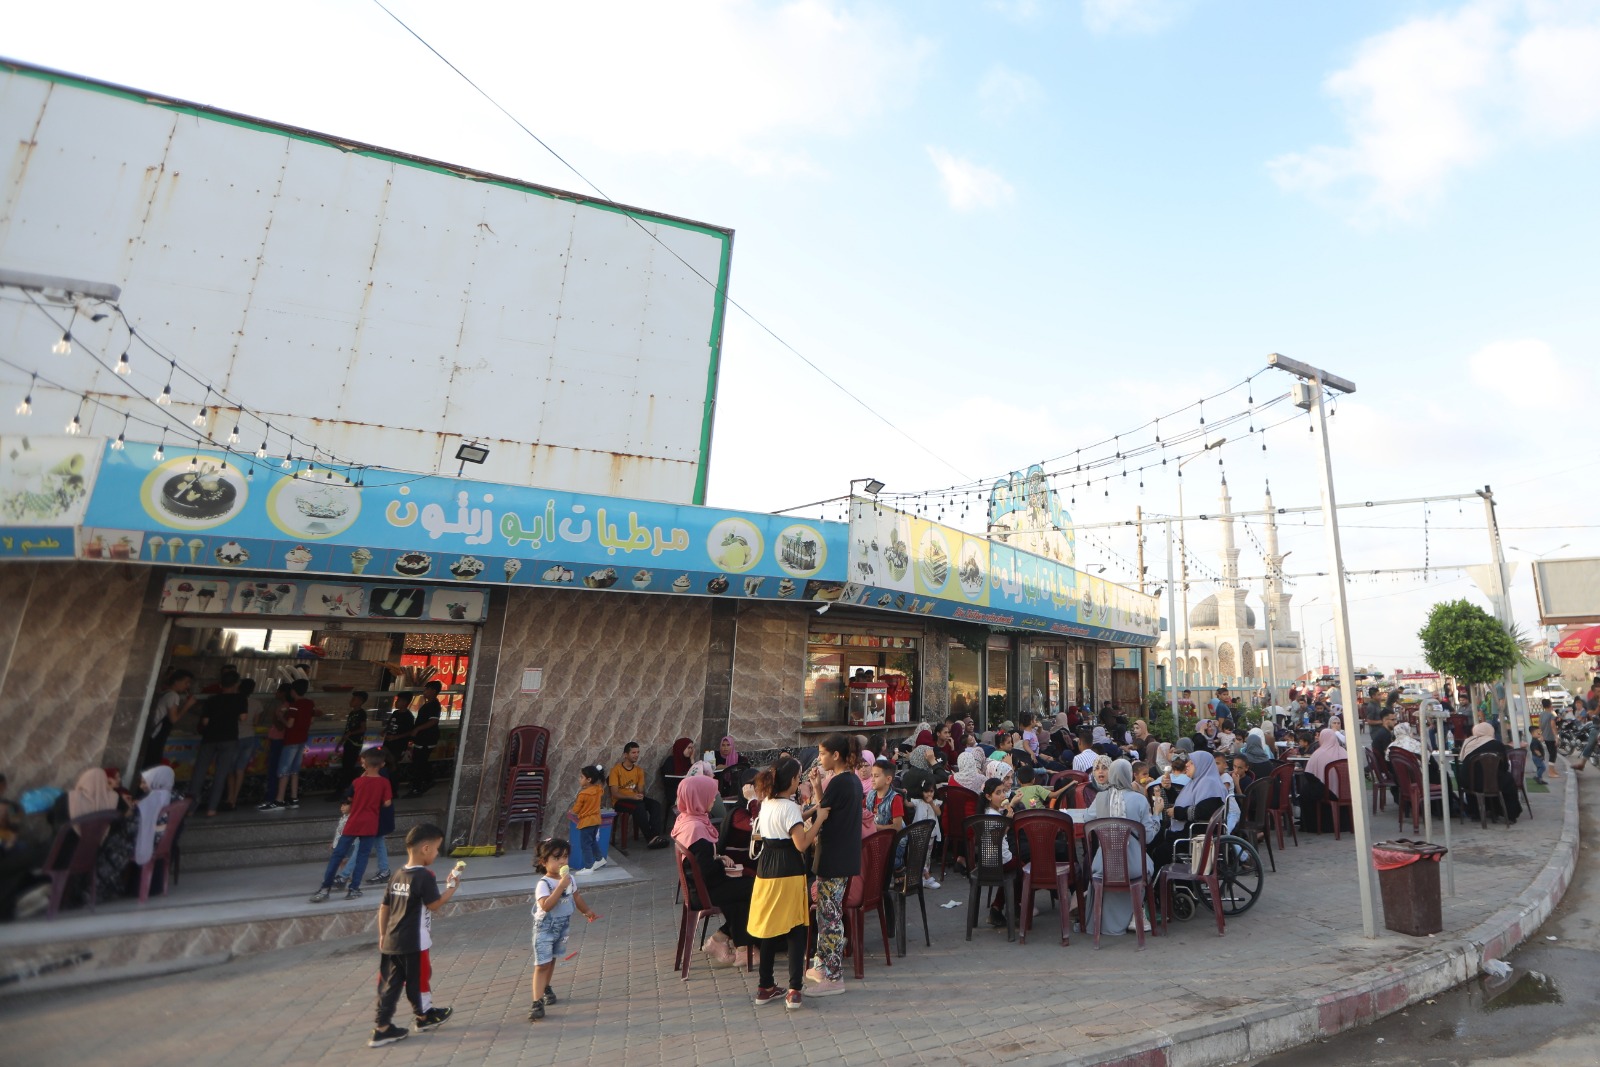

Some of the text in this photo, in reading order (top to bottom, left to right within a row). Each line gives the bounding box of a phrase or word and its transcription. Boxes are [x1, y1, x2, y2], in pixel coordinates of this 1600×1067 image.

[385, 486, 690, 557] مرطبات أبو زيتون
[21, 536, 60, 555] طعم
